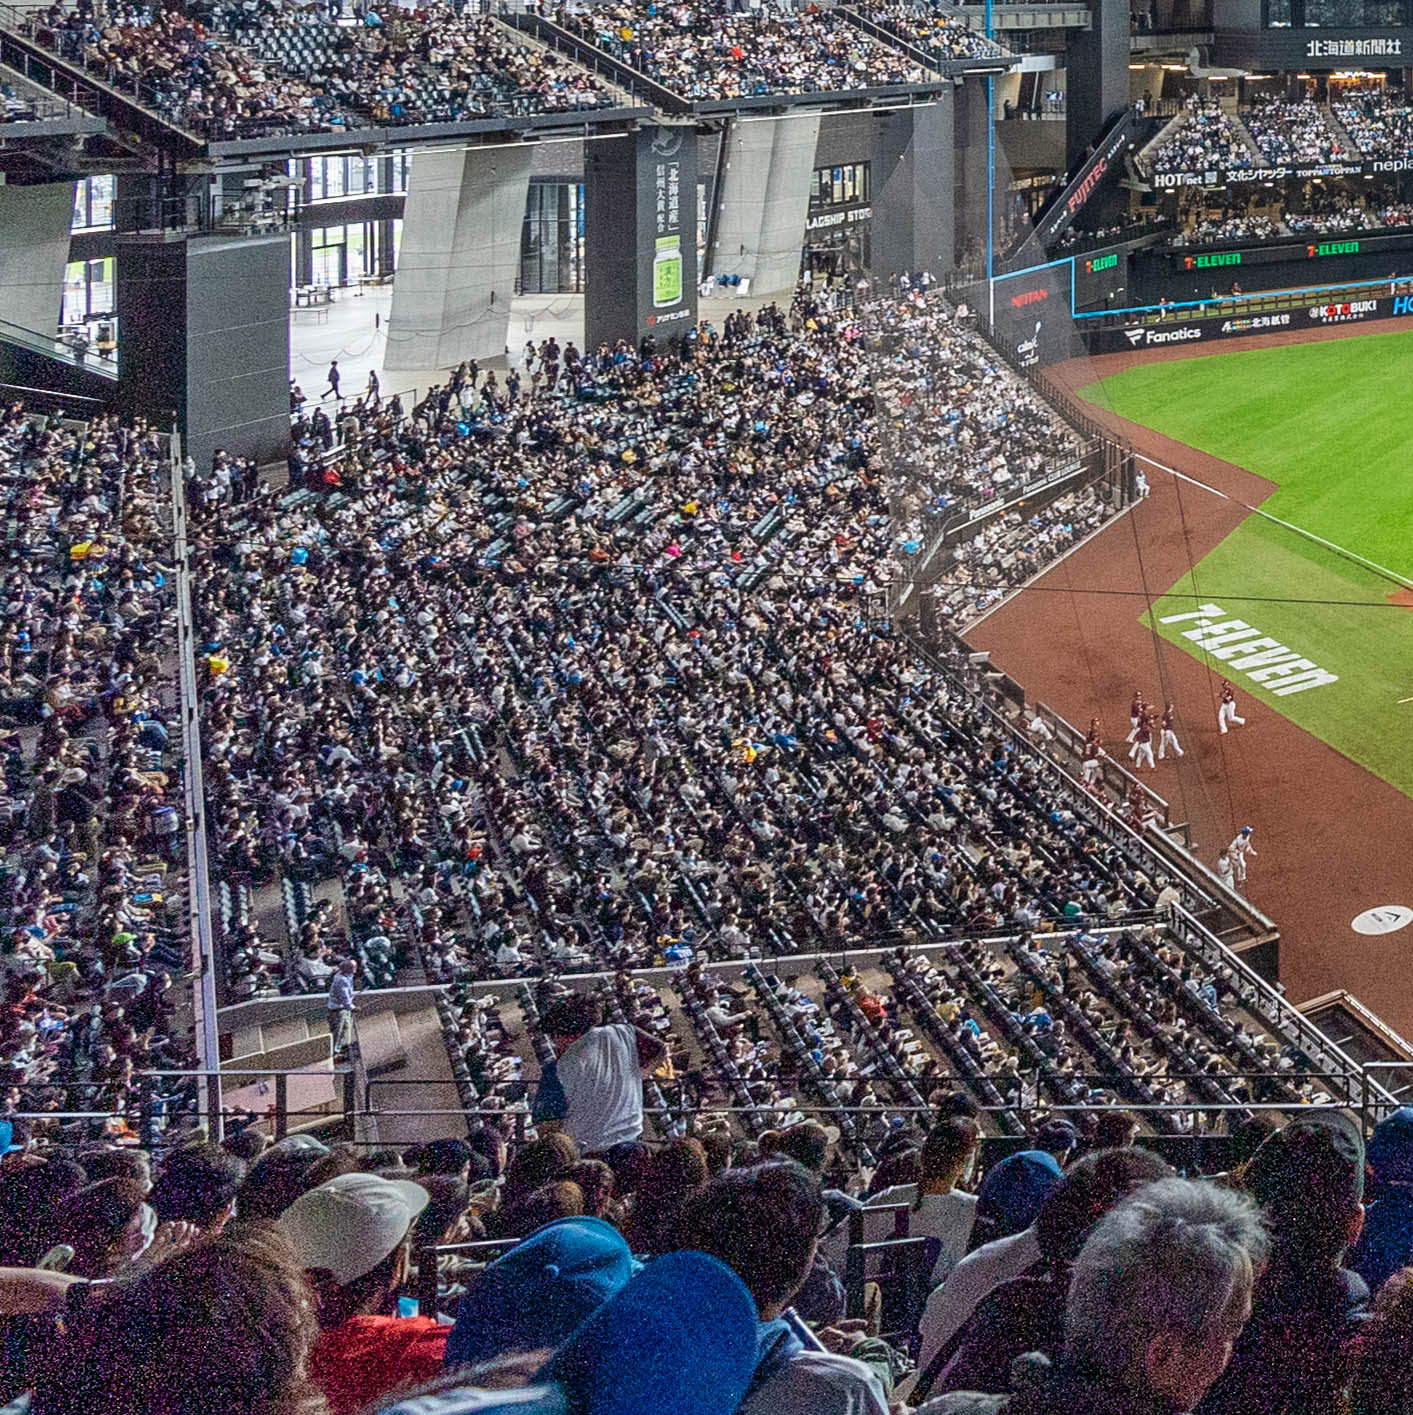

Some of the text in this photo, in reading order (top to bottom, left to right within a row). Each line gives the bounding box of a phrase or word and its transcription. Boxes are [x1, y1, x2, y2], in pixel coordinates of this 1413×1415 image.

[1306, 39, 1401, 57] 北海道新聞社
[1067, 157, 1108, 213] FUJITEC
[1307, 241, 1359, 257] 7-ELEVEN
[1086, 254, 1118, 273] 7-ELEVEN
[1184, 252, 1242, 270] 7-ELEVEN
[1319, 300, 1377, 317] KOTOBUKI
[1146, 327, 1201, 344] Fanatics
[1159, 603, 1339, 696] 7-ELEVEN
